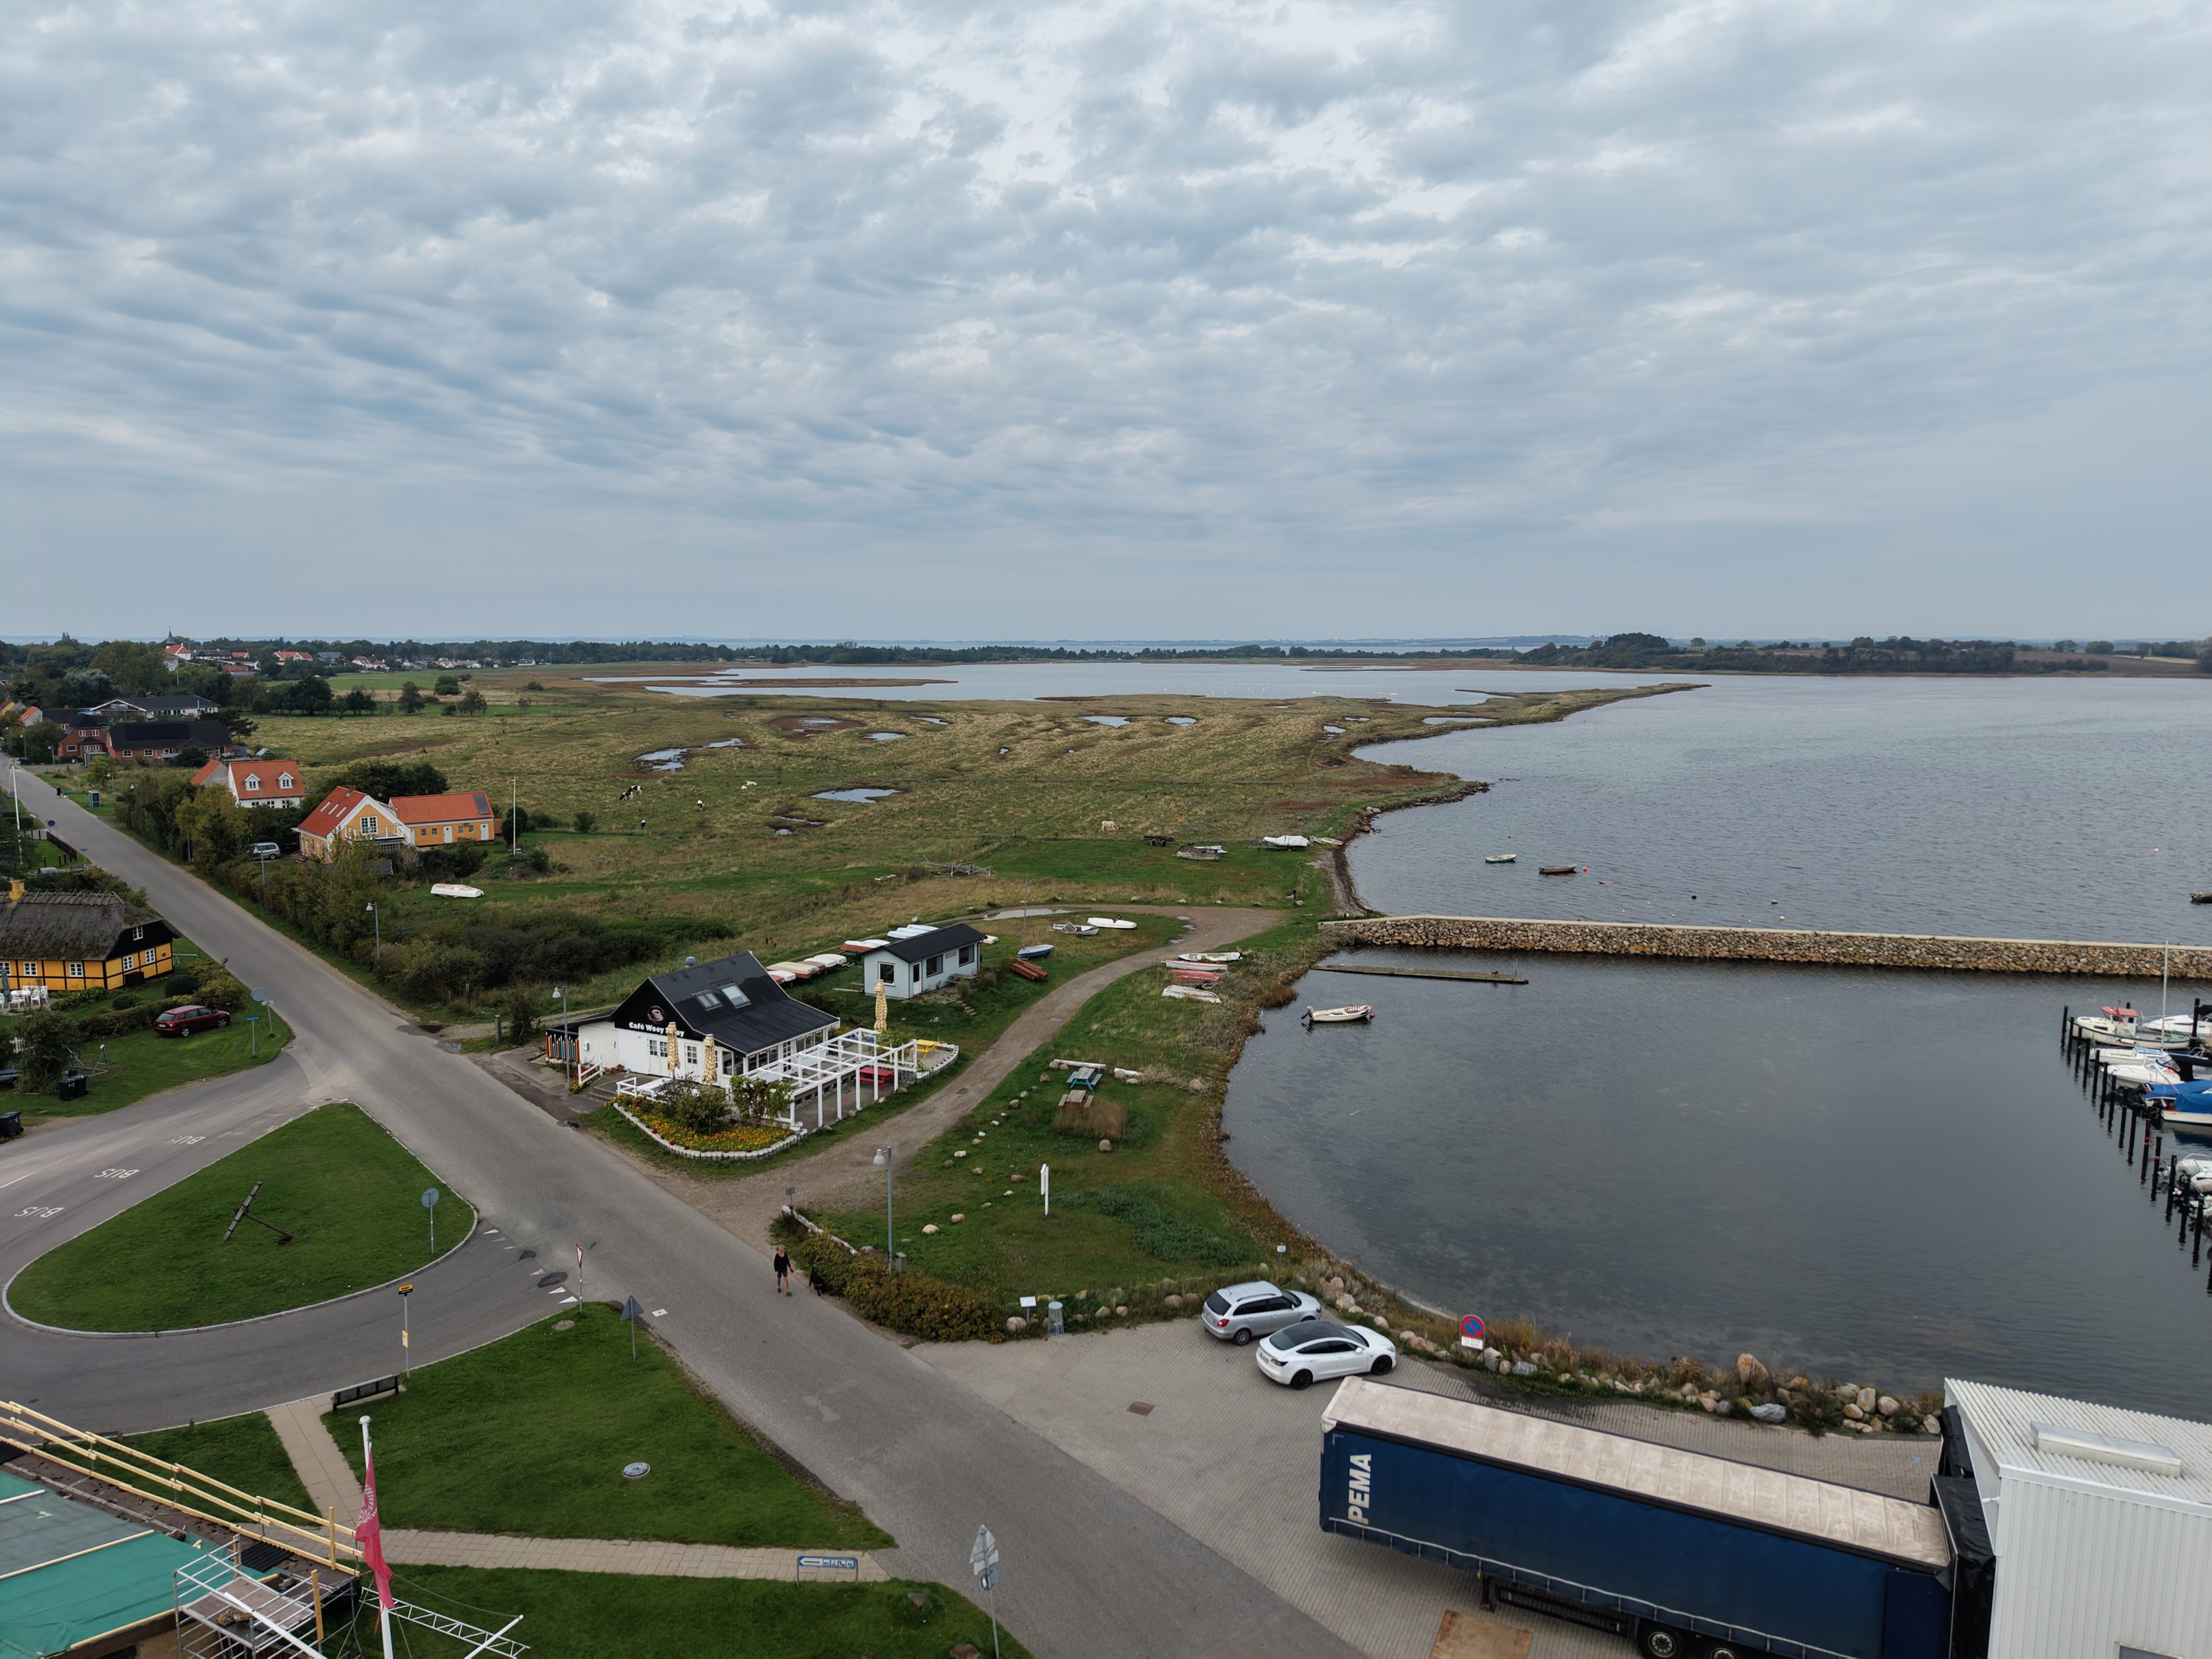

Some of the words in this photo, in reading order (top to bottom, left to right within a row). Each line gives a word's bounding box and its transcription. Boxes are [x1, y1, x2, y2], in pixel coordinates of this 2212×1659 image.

[168, 1135, 206, 1144] BU
[94, 1168, 140, 1178] BUS
[13, 1206, 65, 1218] BUS
[1348, 1454, 1371, 1525] PEMA
